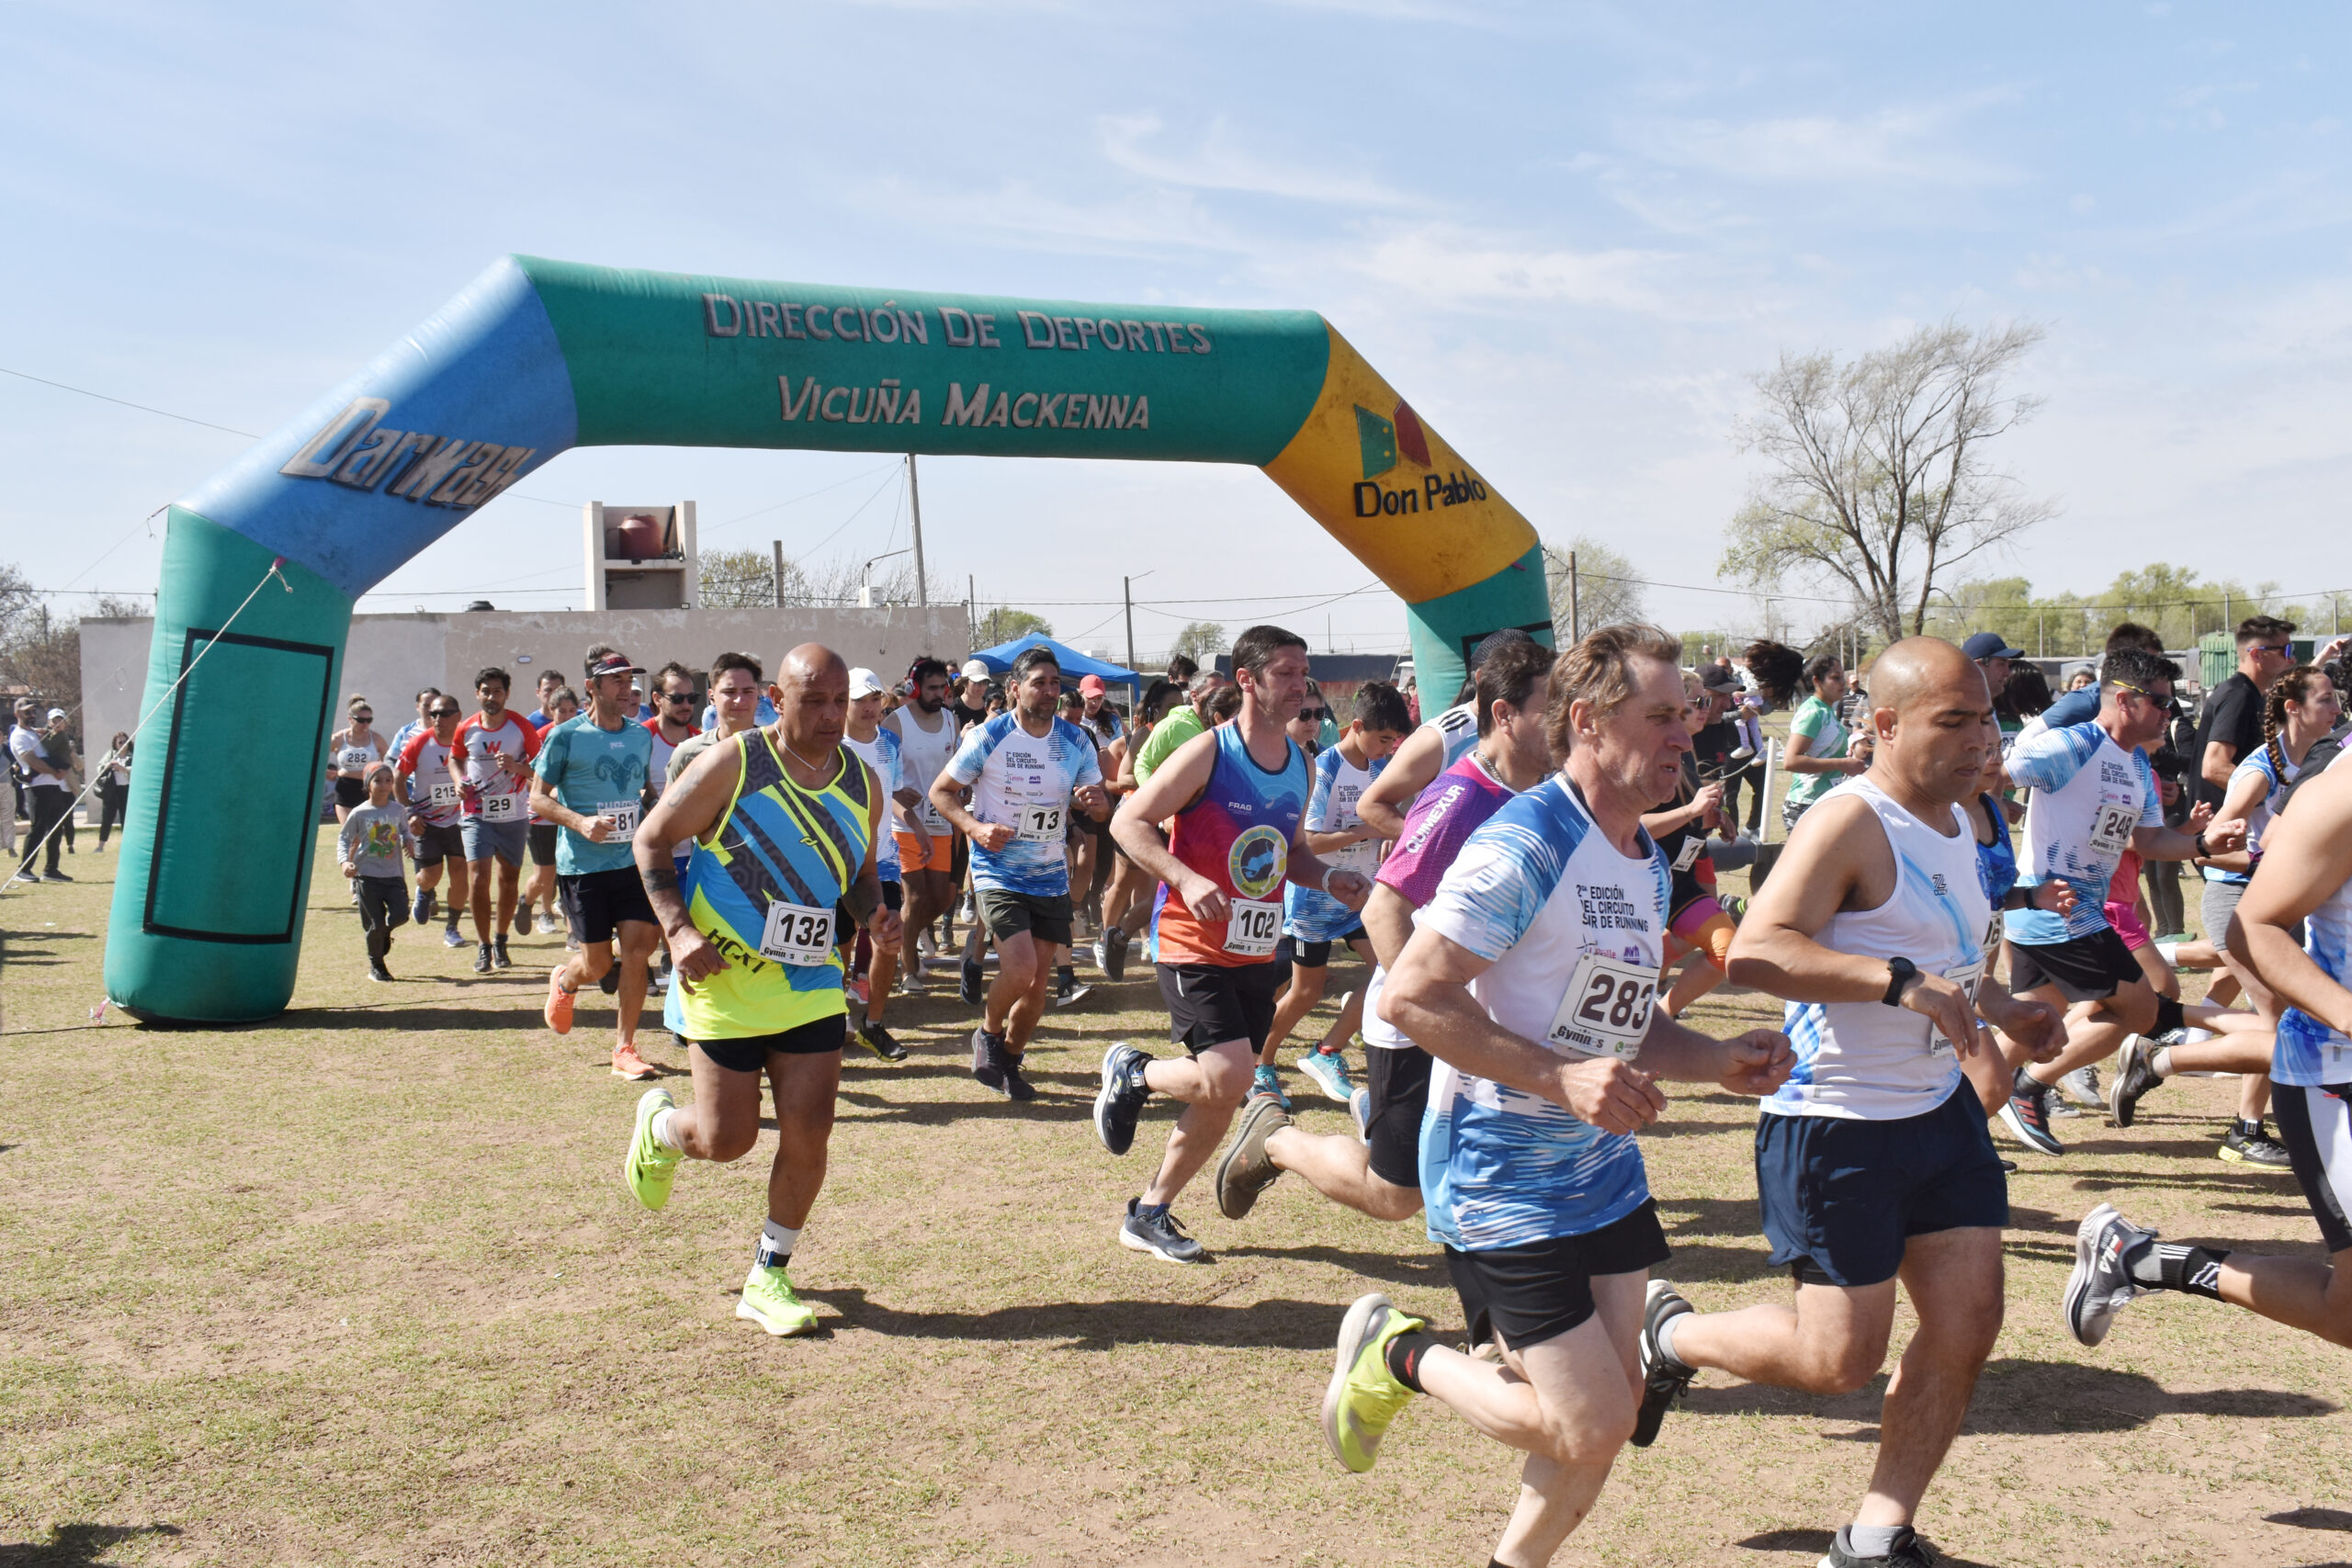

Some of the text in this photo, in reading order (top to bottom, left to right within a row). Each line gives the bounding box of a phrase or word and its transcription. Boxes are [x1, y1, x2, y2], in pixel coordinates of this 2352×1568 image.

[938, 307, 1001, 347] DE
[1017, 310, 1215, 355] DEPORTES
[941, 383, 1149, 430] MACKENNA
[1353, 469, 1487, 518] Don Pablo
[347, 753, 367, 763] 282
[435, 785, 458, 799] 215
[489, 798, 511, 812] 29
[1228, 801, 1252, 811] FRAG
[1032, 810, 1059, 830] 13
[1406, 784, 1465, 853] QUIMEXUR
[2104, 812, 2132, 840] 248
[1590, 884, 1624, 900] EDICIÓN
[1599, 900, 1634, 916] CIRCUITO
[780, 913, 829, 947] 132
[1240, 909, 1276, 939] 102
[1600, 915, 1613, 929] DE
[1615, 915, 1649, 932] RUNNING
[1578, 974, 1656, 1030] 283
[2098, 1234, 2125, 1274] FILA
